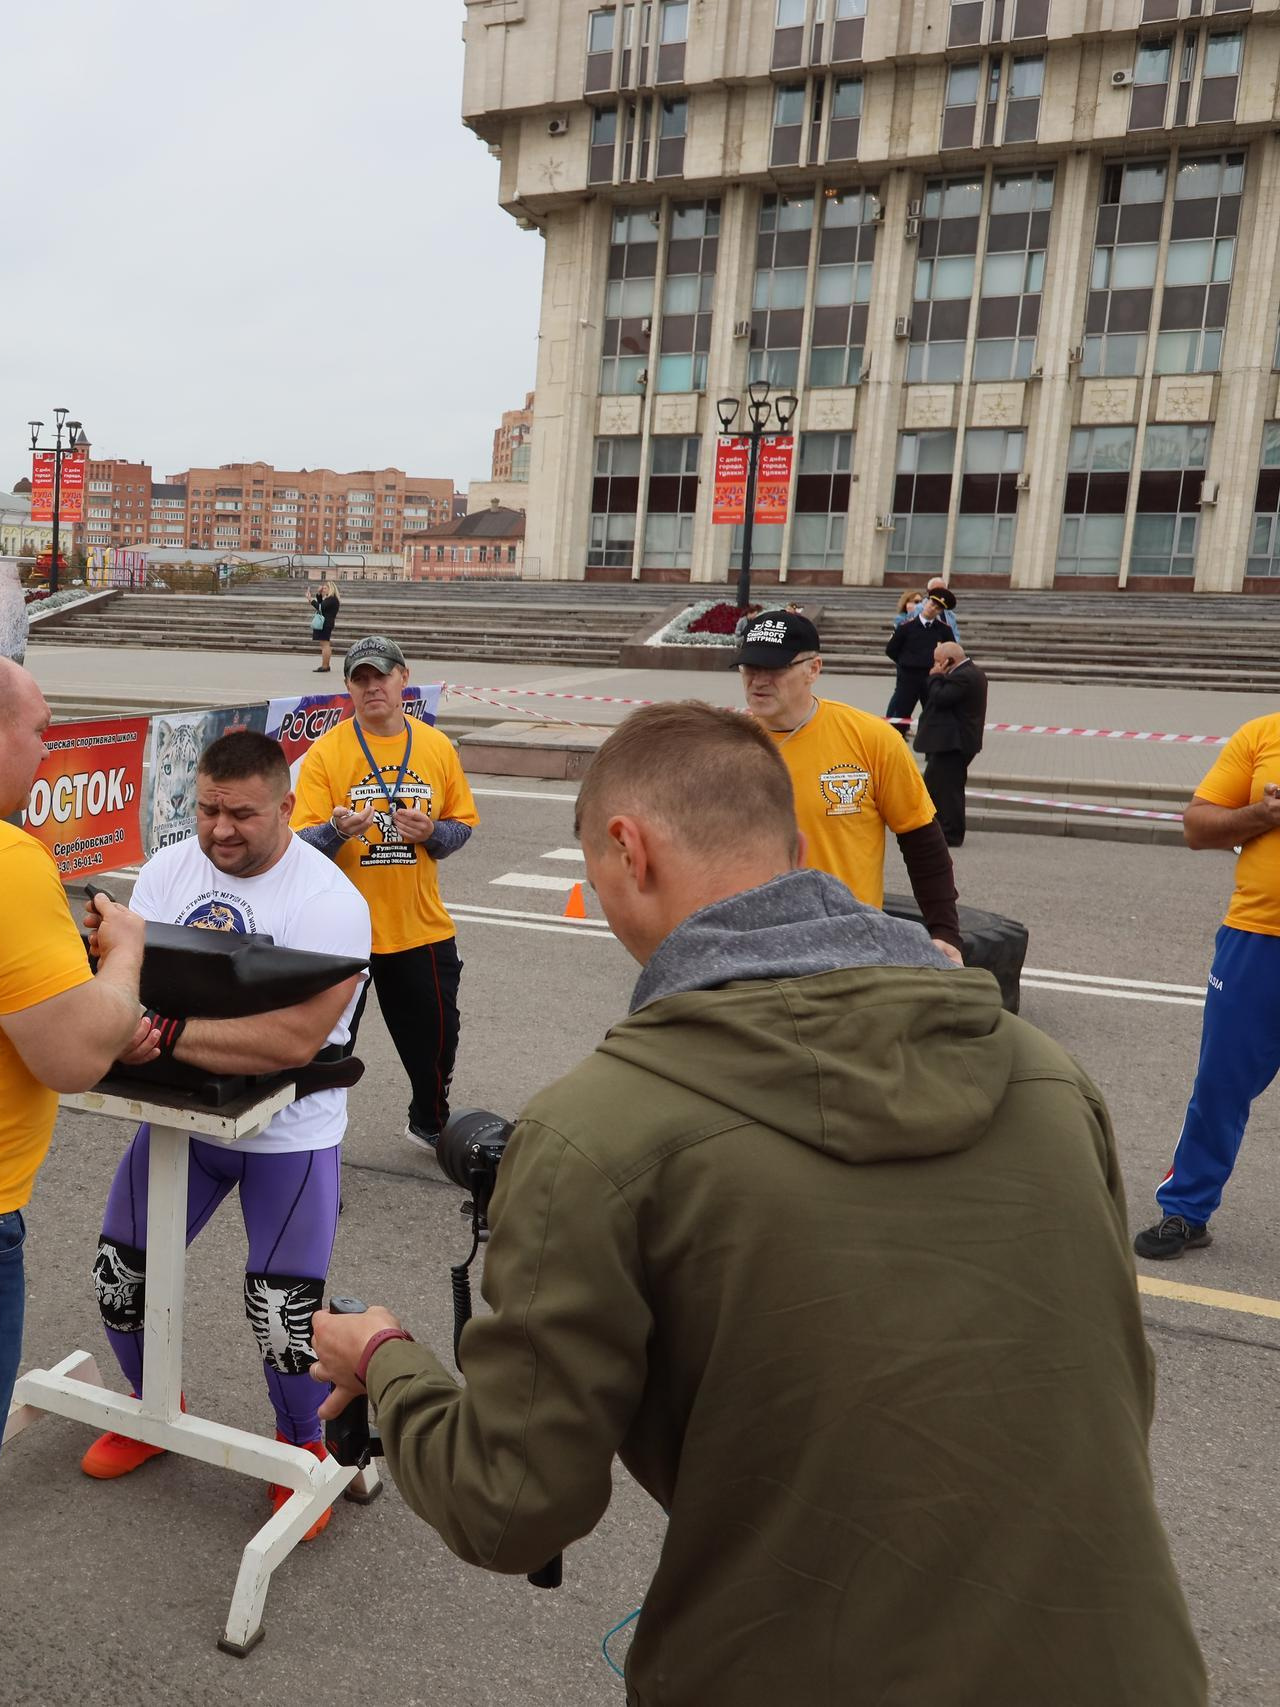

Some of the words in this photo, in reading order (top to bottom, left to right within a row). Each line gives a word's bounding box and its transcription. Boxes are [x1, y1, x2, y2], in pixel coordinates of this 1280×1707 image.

[277, 708, 344, 742] РОССИЯ
[76, 735, 116, 749] спортивная
[116, 732, 137, 743] школа
[21, 766, 135, 827] ОСТОК»
[54, 834, 113, 856] Серебровская
[114, 829, 125, 842] 30
[73, 853, 103, 869] 36-01-42
[175, 911, 186, 924] THE
[244, 905, 254, 918] THE
